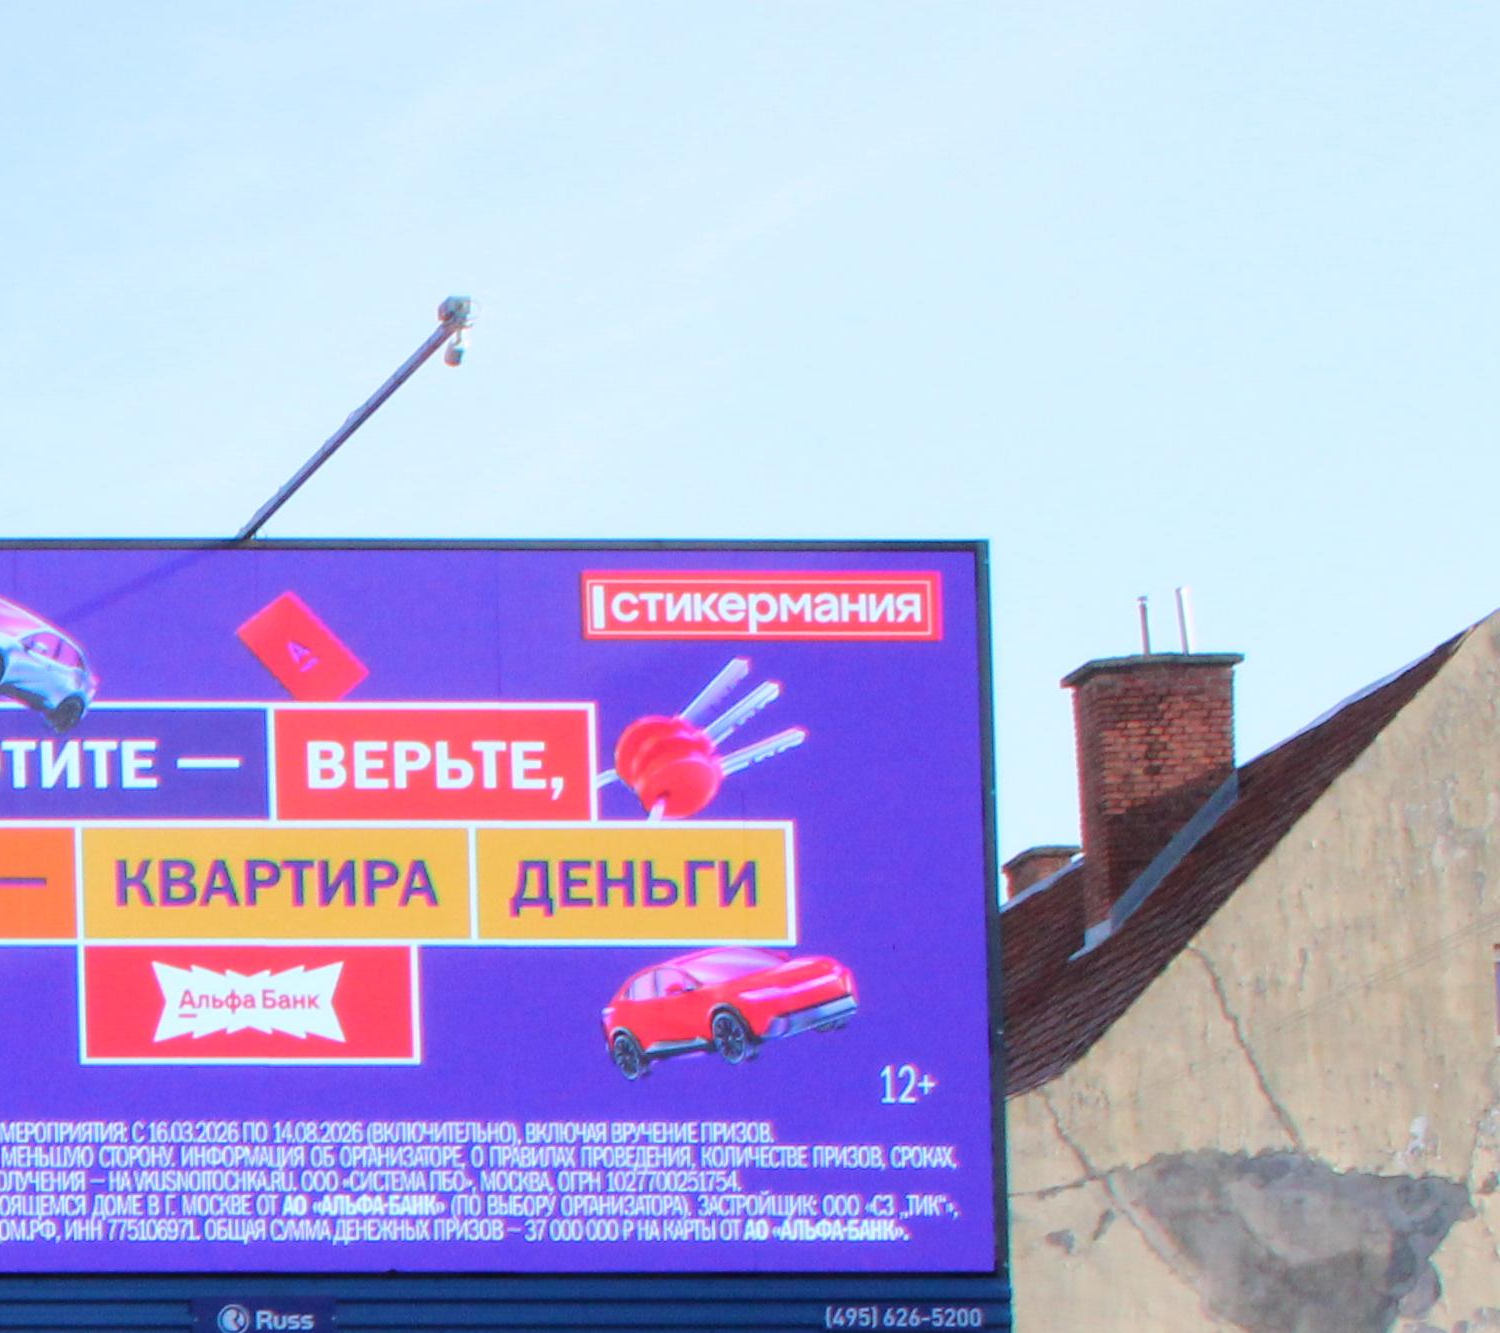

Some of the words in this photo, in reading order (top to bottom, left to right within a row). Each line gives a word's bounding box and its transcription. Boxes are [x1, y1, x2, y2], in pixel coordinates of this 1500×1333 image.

[611, 590, 923, 635] стикермания
[305, 741, 565, 799] ВЕРЬТЕ,
[115, 857, 439, 907] КВАРТИРА
[511, 858, 760, 917] ДЕНЬГИ
[178, 988, 256, 1018] Альфа
[261, 989, 320, 1009] Банк
[879, 1064, 937, 1104] 12+
[1, 1121, 128, 1143] МЕРОПРИЯТИЯ:
[132, 1121, 146, 1143] С
[149, 1121, 238, 1143] 16.03.2026
[242, 1121, 268, 1143] ПО
[525, 1121, 607, 1143] ВКЛЮЧАЯ
[611, 1121, 698, 1143] ВРУЧЕНИЕ
[701, 1121, 775, 1143] ПРИЗОВ.
[2, 1147, 93, 1169] МЕНЬШУЮ
[99, 1147, 176, 1169] СТОРОНУ.
[181, 1147, 305, 1173] ИНФОРМАЦИЯ
[311, 1147, 335, 1169] ОБ
[471, 1147, 484, 1169] О
[489, 1147, 575, 1169] ПРАВИЛАХ
[701, 1147, 807, 1169] КОЛИЧЕСТВЕ
[812, 1147, 886, 1173] ПРИЗОВ,
[108, 1171, 134, 1192] НА
[302, 1171, 338, 1192] ООО
[557, 1171, 601, 1192] ОГРН
[91, 1196, 145, 1221] ДОМЕ
[149, 1196, 161, 1217] В
[181, 1196, 252, 1217] МОСКВЕ
[256, 1196, 278, 1217] ОТ
[282, 1196, 307, 1217] АО
[486, 1196, 558, 1217] ВЫБОРУ
[822, 1196, 861, 1217] ООО
[65, 1219, 101, 1242] ИНН
[205, 1219, 266, 1246] ОБЩАЯ
[269, 1219, 331, 1242] СУММА
[332, 1219, 429, 1246] ДЕНЕЖНЫХ
[433, 1219, 505, 1242] ПРИЗОВ
[524, 1219, 545, 1242] 37
[550, 1219, 582, 1242] 000
[586, 1219, 619, 1242] 000
[637, 1219, 661, 1242] НА
[663, 1219, 716, 1242] КАРТЫ
[721, 1219, 740, 1242] ОТ
[744, 1219, 768, 1242] АО
[255, 1309, 315, 1331] Russ
[824, 1305, 878, 1329] (495)
[883, 1306, 983, 1328] 626-5200
